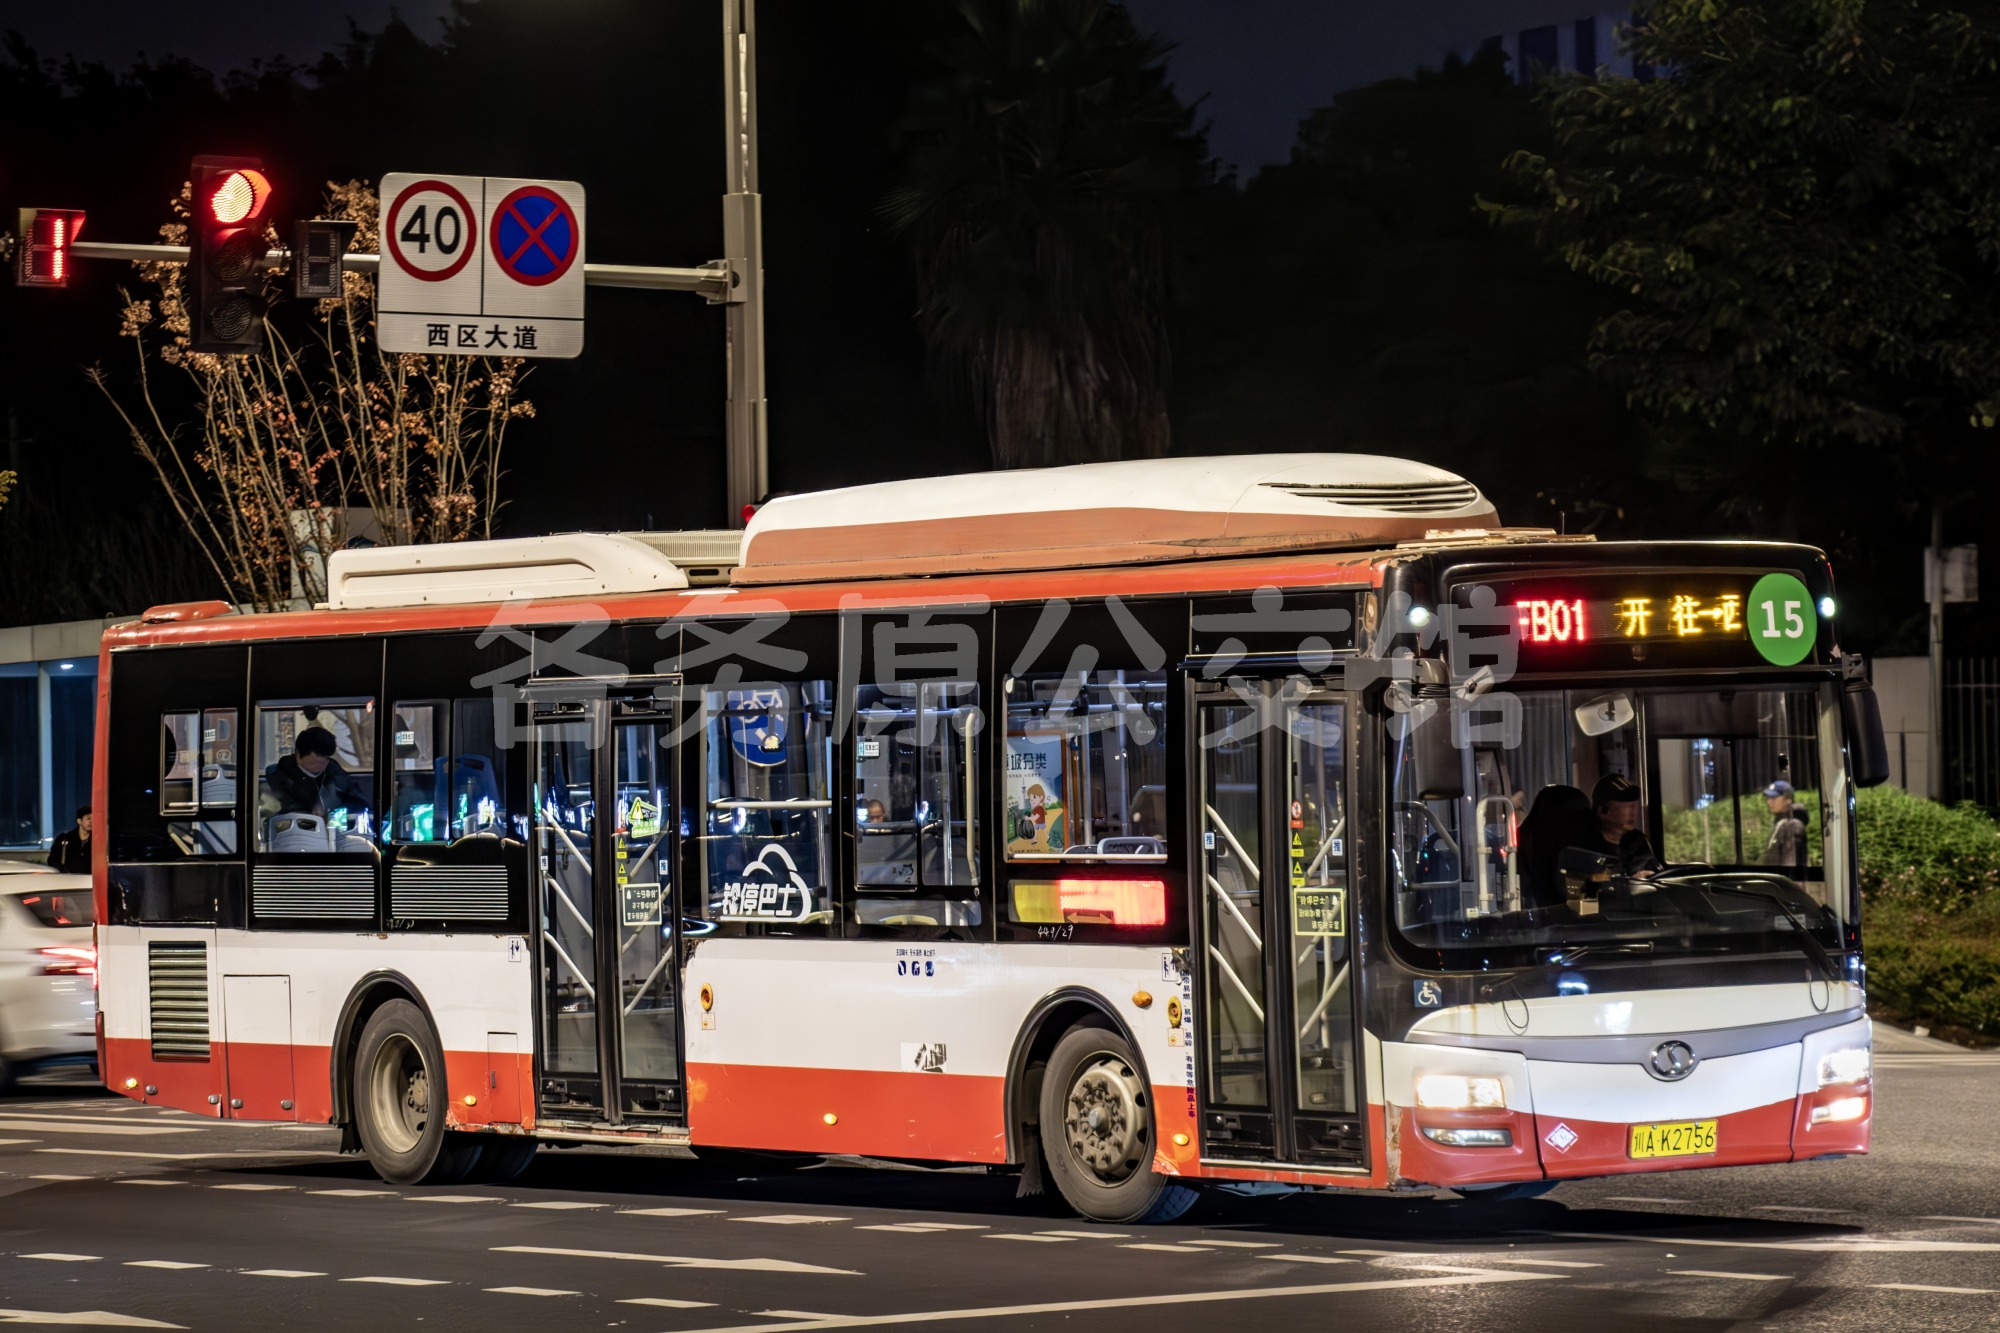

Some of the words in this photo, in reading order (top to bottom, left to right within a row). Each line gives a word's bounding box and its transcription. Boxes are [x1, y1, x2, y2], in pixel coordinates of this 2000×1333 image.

[401, 204, 461, 255] 40
[426, 323, 538, 350] 西区大道
[1761, 600, 1803, 638] 15
